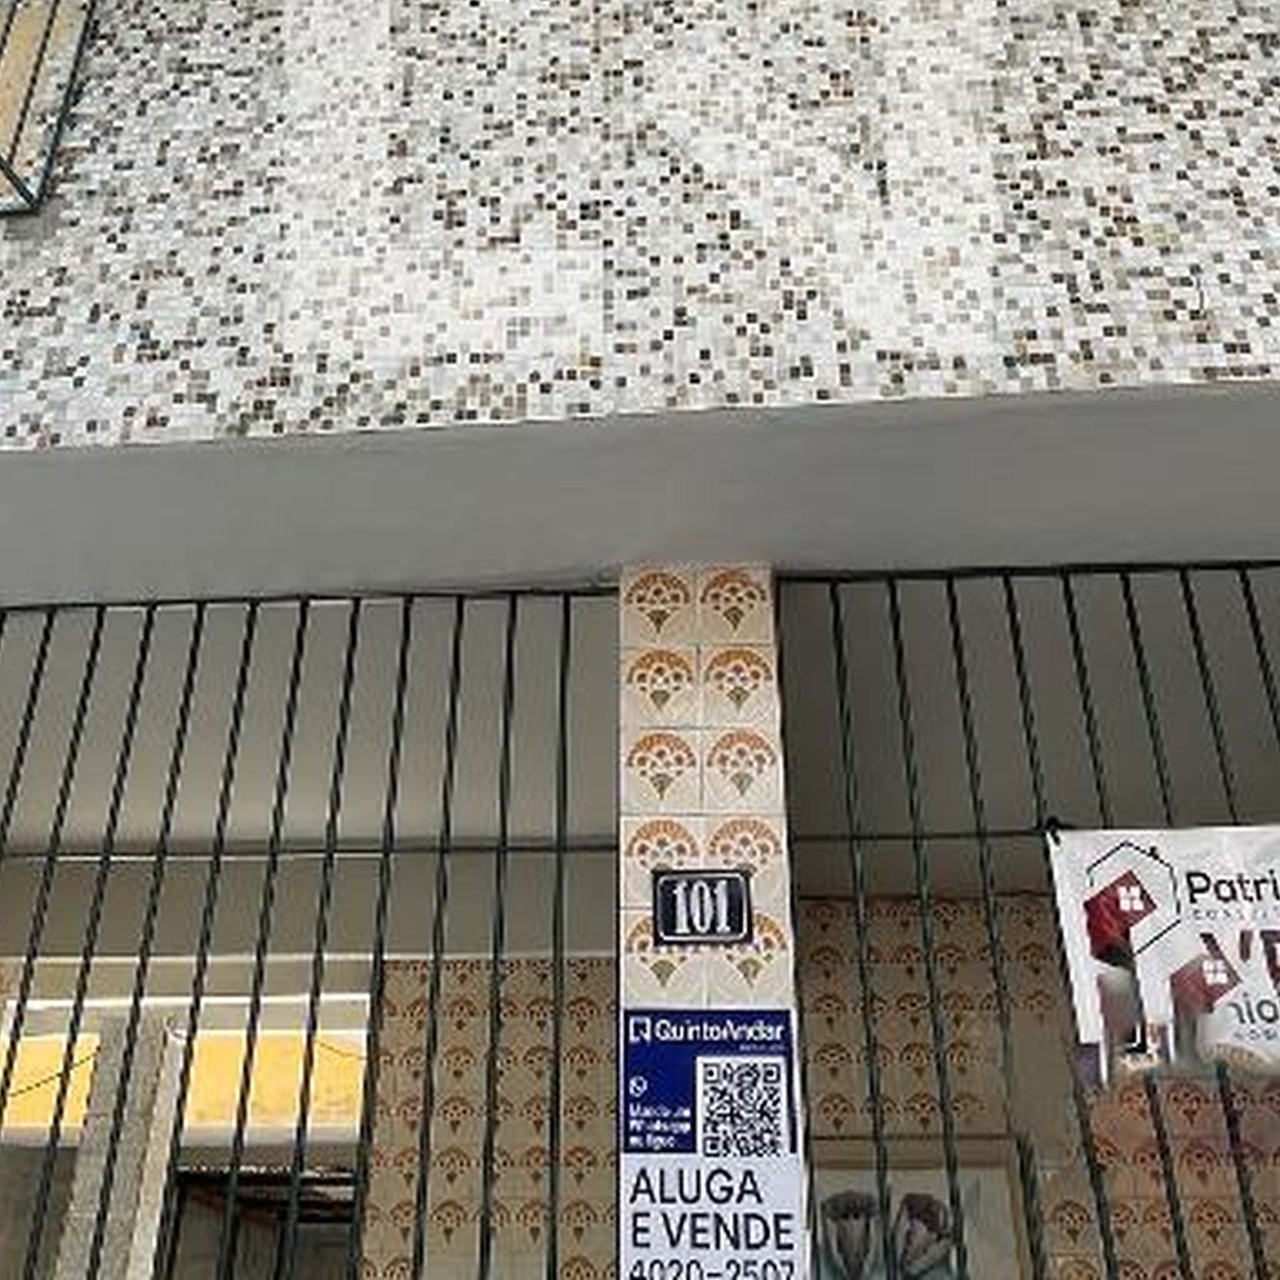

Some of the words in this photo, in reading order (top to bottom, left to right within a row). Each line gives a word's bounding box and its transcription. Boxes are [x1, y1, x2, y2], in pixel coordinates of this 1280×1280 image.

[673, 879, 732, 934] 101
[654, 1019, 786, 1042] QuintoAndar
[629, 1167, 763, 1204] ALUGA
[632, 1212, 651, 1248] E
[662, 1212, 794, 1250] VENDE
